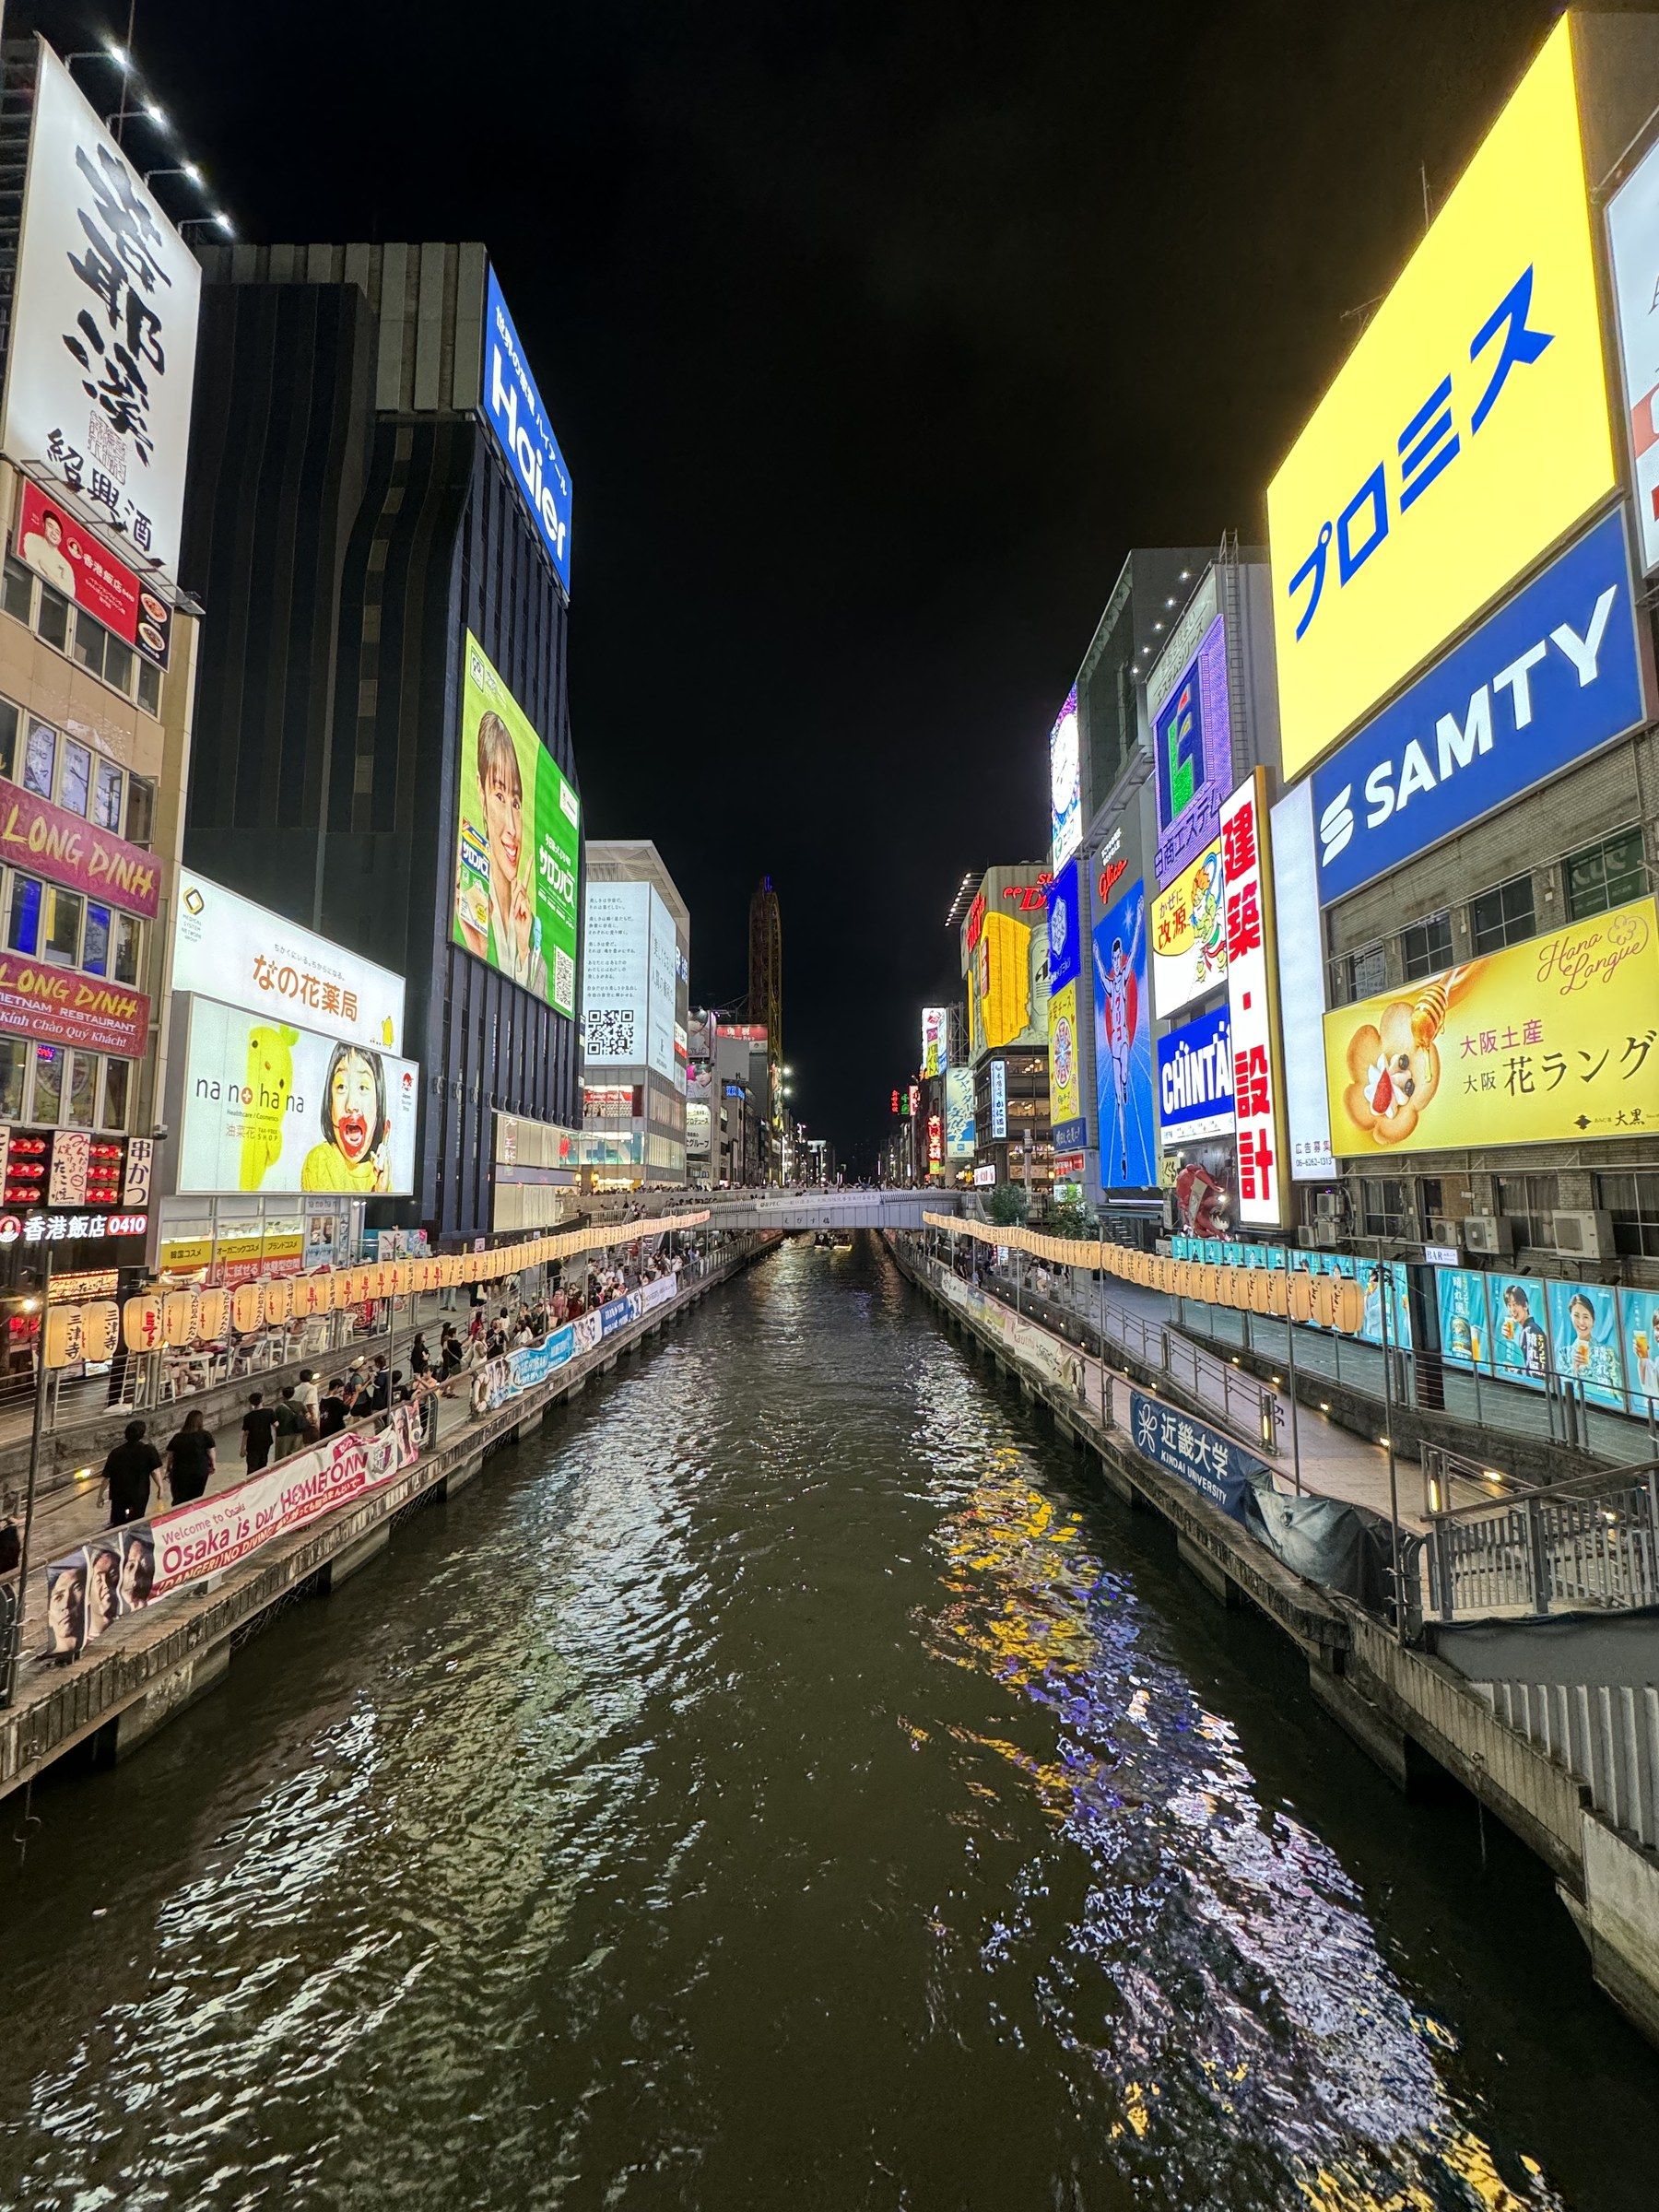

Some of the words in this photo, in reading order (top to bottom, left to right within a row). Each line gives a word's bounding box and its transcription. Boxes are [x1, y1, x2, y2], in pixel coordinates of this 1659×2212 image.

[492, 343, 566, 560] Haier
[536, 414, 567, 496] ハイアール
[1288, 262, 1556, 643] プロミス
[47, 428, 151, 552] 紹興酒
[1365, 584, 1618, 830] SAMTY
[1, 804, 84, 865] LONG
[93, 842, 153, 899] DINH
[1155, 791, 1225, 877] 日商エステム
[540, 843, 574, 908] サロンパス
[1158, 902, 1190, 950] 改源
[1159, 888, 1182, 918] かぜに
[1537, 935, 1602, 990] Hana
[1559, 941, 1649, 996] Langue
[0, 962, 71, 1001] LONG
[75, 985, 137, 1018] DINH
[0, 994, 52, 1014] IETNAM
[60, 1007, 135, 1032] RESTAURANT
[253, 954, 359, 1023] なの花薬局
[1222, 800, 1273, 1200] 建築・設計
[33, 1015, 63, 1034] Chào
[66, 1022, 89, 1041] Quý
[92, 1031, 127, 1048] Khách!
[1460, 1019, 1544, 1059] 大阪土産
[1464, 1070, 1496, 1094] 大阪
[1503, 1030, 1658, 1096] 花ラング
[195, 1076, 220, 1101] na
[260, 1083, 280, 1111] ha
[286, 1092, 304, 1115] na
[227, 1109, 252, 1118] Healthcare
[256, 1112, 279, 1122] Cosmetics
[1615, 1108, 1645, 1126] 大黒
[128, 1140, 150, 1204] 串かつ
[1296, 1141, 1331, 1154] 広告募集
[52, 1159, 74, 1202] たこ焼
[24, 1215, 107, 1241] 香港飯店
[109, 1218, 146, 1233] 0410
[217, 1244, 260, 1256] オーガニックコスメ
[267, 1241, 298, 1251] ブランドコスメ
[171, 1249, 202, 1259] 韓国コスメ
[1427, 1250, 1443, 1261] BAR
[65, 1314, 82, 1359] 三津寺
[104, 1310, 118, 1350] 三津寺
[1160, 1413, 1228, 1480] 近畿大学
[1160, 1450, 1185, 1473] KINDAI
[1187, 1467, 1228, 1505] UNIVERSITY
[161, 1520, 211, 1546] Welcome
[212, 1512, 224, 1526] to
[225, 1502, 246, 1519] Osaka
[162, 1525, 230, 1574] Osaka
[236, 1516, 250, 1541] is
